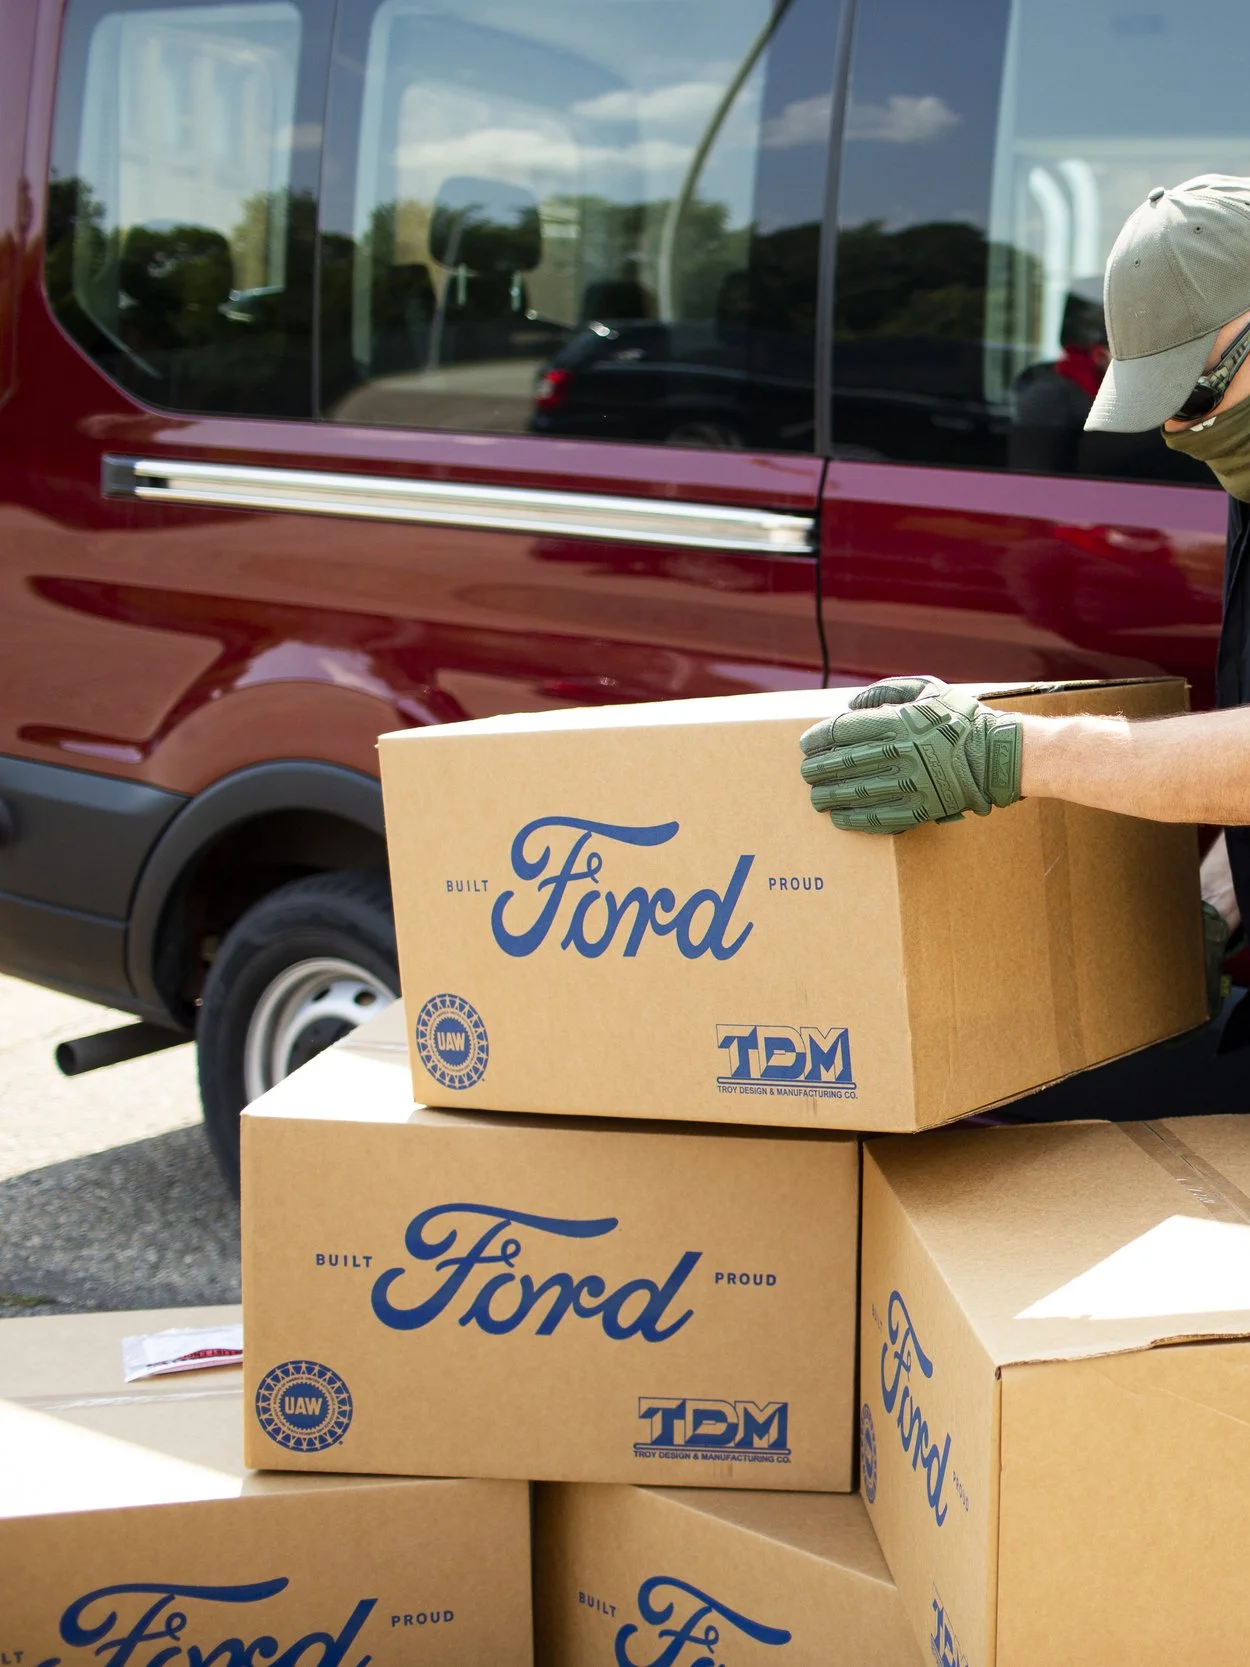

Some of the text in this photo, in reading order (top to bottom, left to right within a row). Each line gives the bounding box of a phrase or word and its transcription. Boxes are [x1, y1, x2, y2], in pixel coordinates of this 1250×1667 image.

[445, 815, 825, 961] BUILT Ford PROUD
[437, 1031, 466, 1051] UAW
[715, 1024, 853, 1082] TDM
[717, 1085, 858, 1099] TROY DESIGN & MANUFACTURING CO.
[315, 1202, 778, 1343] BUILT Ford PROUD
[284, 1396, 323, 1416] UAW
[880, 1290, 952, 1527] Ford
[638, 1396, 789, 1450] TDM
[633, 1450, 656, 1458] TROY
[658, 1451, 691, 1460] DESIGN
[692, 1453, 700, 1461] &
[701, 1453, 775, 1463] MANUFACTURING
[578, 1591, 617, 1617] BUILT
[391, 1610, 455, 1628] PROUD
